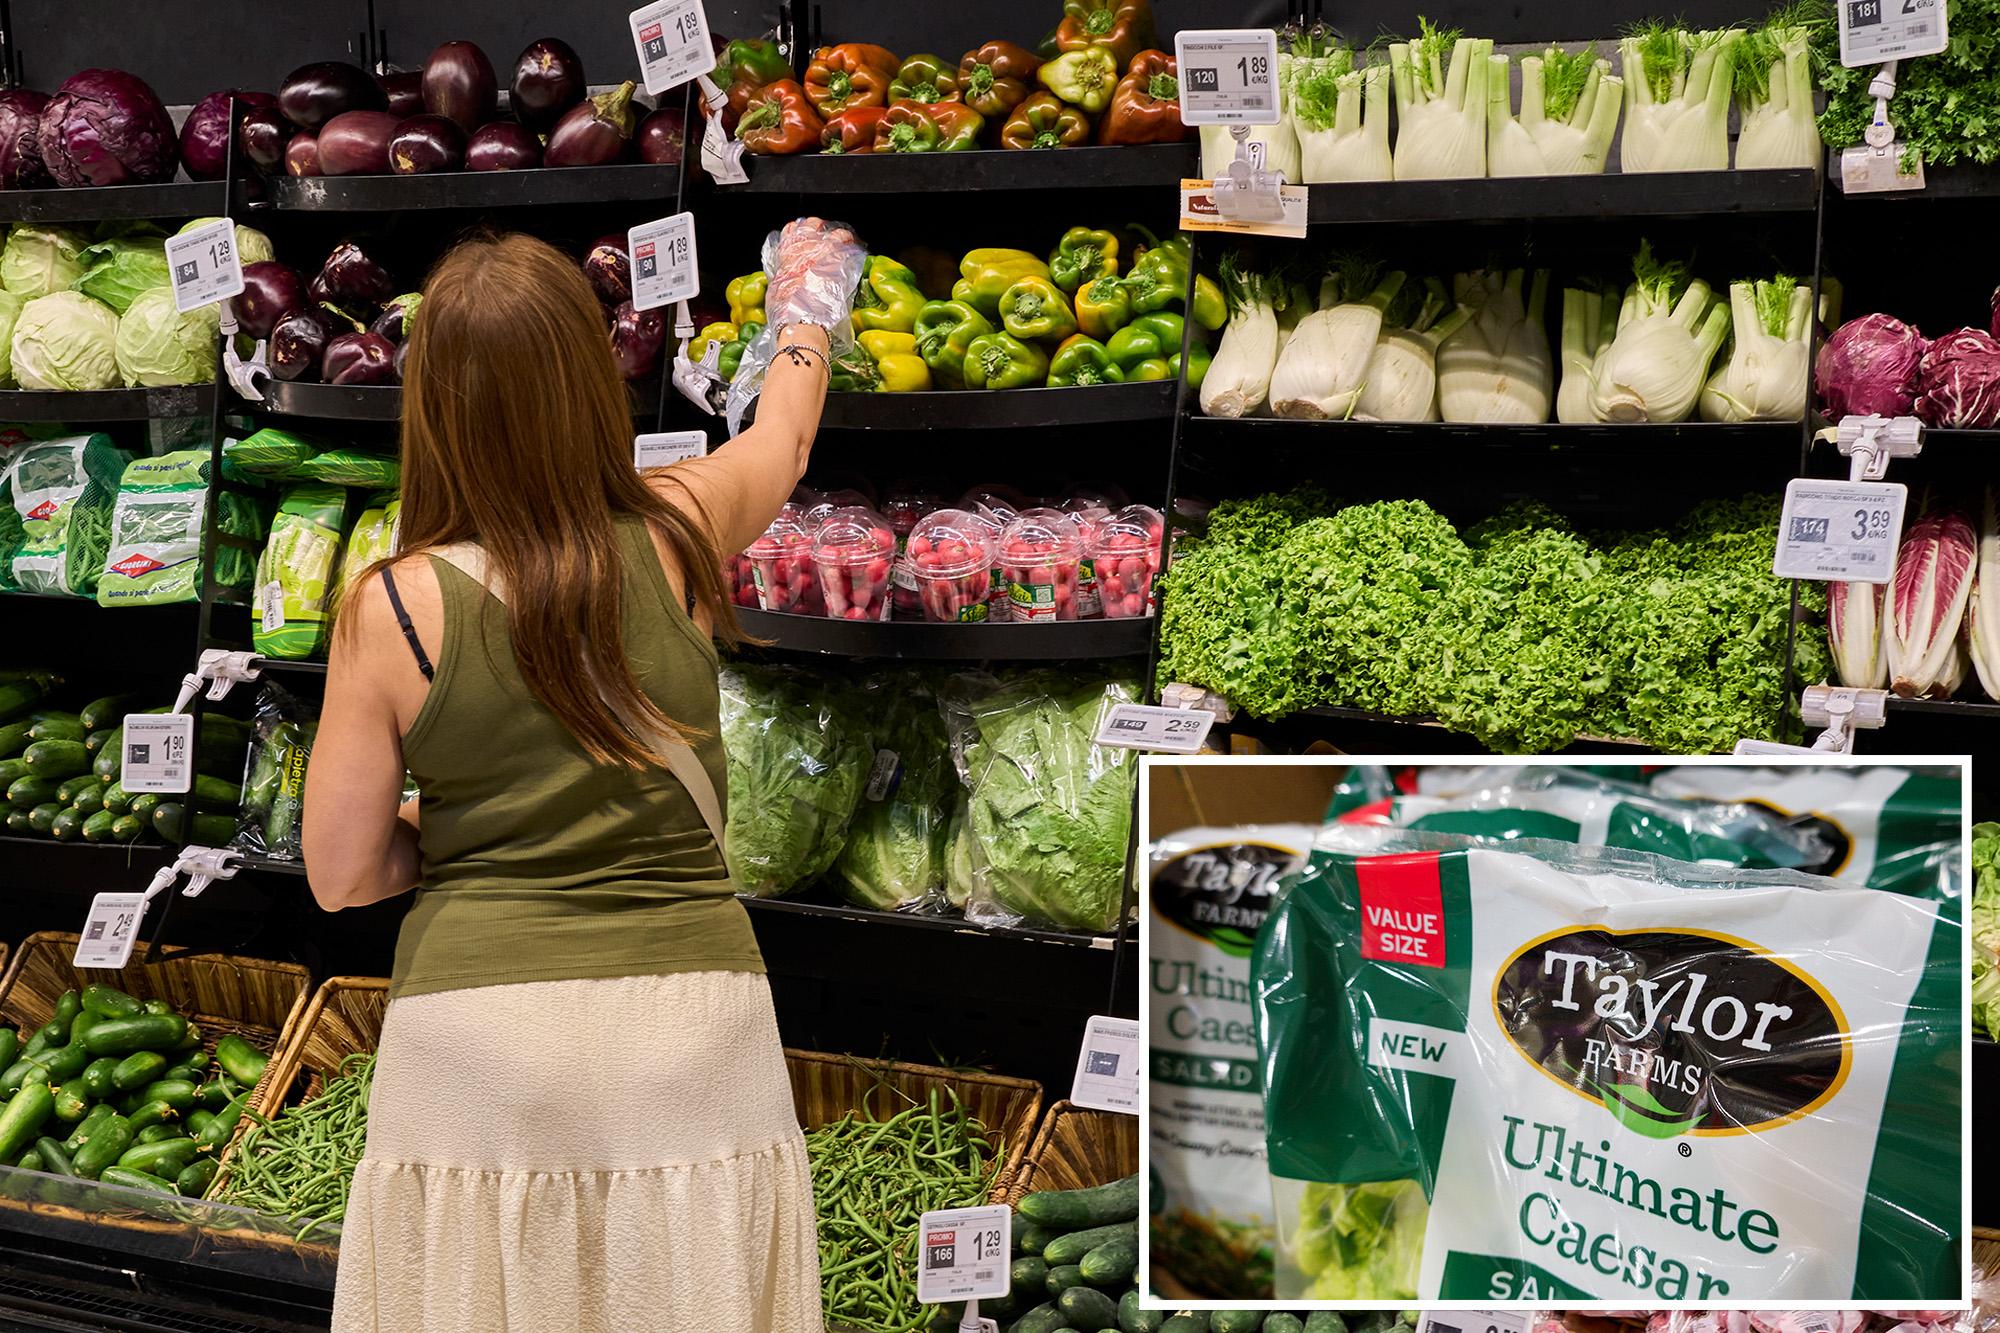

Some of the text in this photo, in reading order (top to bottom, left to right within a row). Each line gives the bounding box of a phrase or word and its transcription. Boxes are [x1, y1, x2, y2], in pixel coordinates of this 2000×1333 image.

[1857, 2, 1877, 18] 181
[676, 17, 687, 44] 1
[685, 12, 698, 30] 89
[651, 40, 661, 53] 91
[1195, 71, 1215, 84] 120
[1238, 57, 1267, 87] 1 89
[209, 245, 218, 268] 1
[218, 240, 230, 256] 29
[668, 237, 687, 266] 1 89
[184, 264, 194, 276] 84
[643, 258, 653, 271] 90
[1801, 520, 1825, 534] 174
[1851, 508, 1868, 540] 3
[1122, 720, 1143, 728] 149
[1165, 720, 1200, 732] 2 59
[163, 736, 184, 760] 1 90
[112, 913, 124, 937] 2
[1366, 905, 1438, 935] VALUE
[1380, 933, 1428, 958] SIZE
[1544, 950, 1793, 1052] Taylor
[1382, 1032, 1447, 1063] NEW
[1582, 1038, 1703, 1097] FARMS
[1503, 1114, 1780, 1255] Ultimate
[928, 1232, 953, 1241] PROMO
[973, 1230, 1000, 1260] 1 29
[1519, 1191, 1730, 1300] Caesar
[934, 1247, 952, 1261] 166
